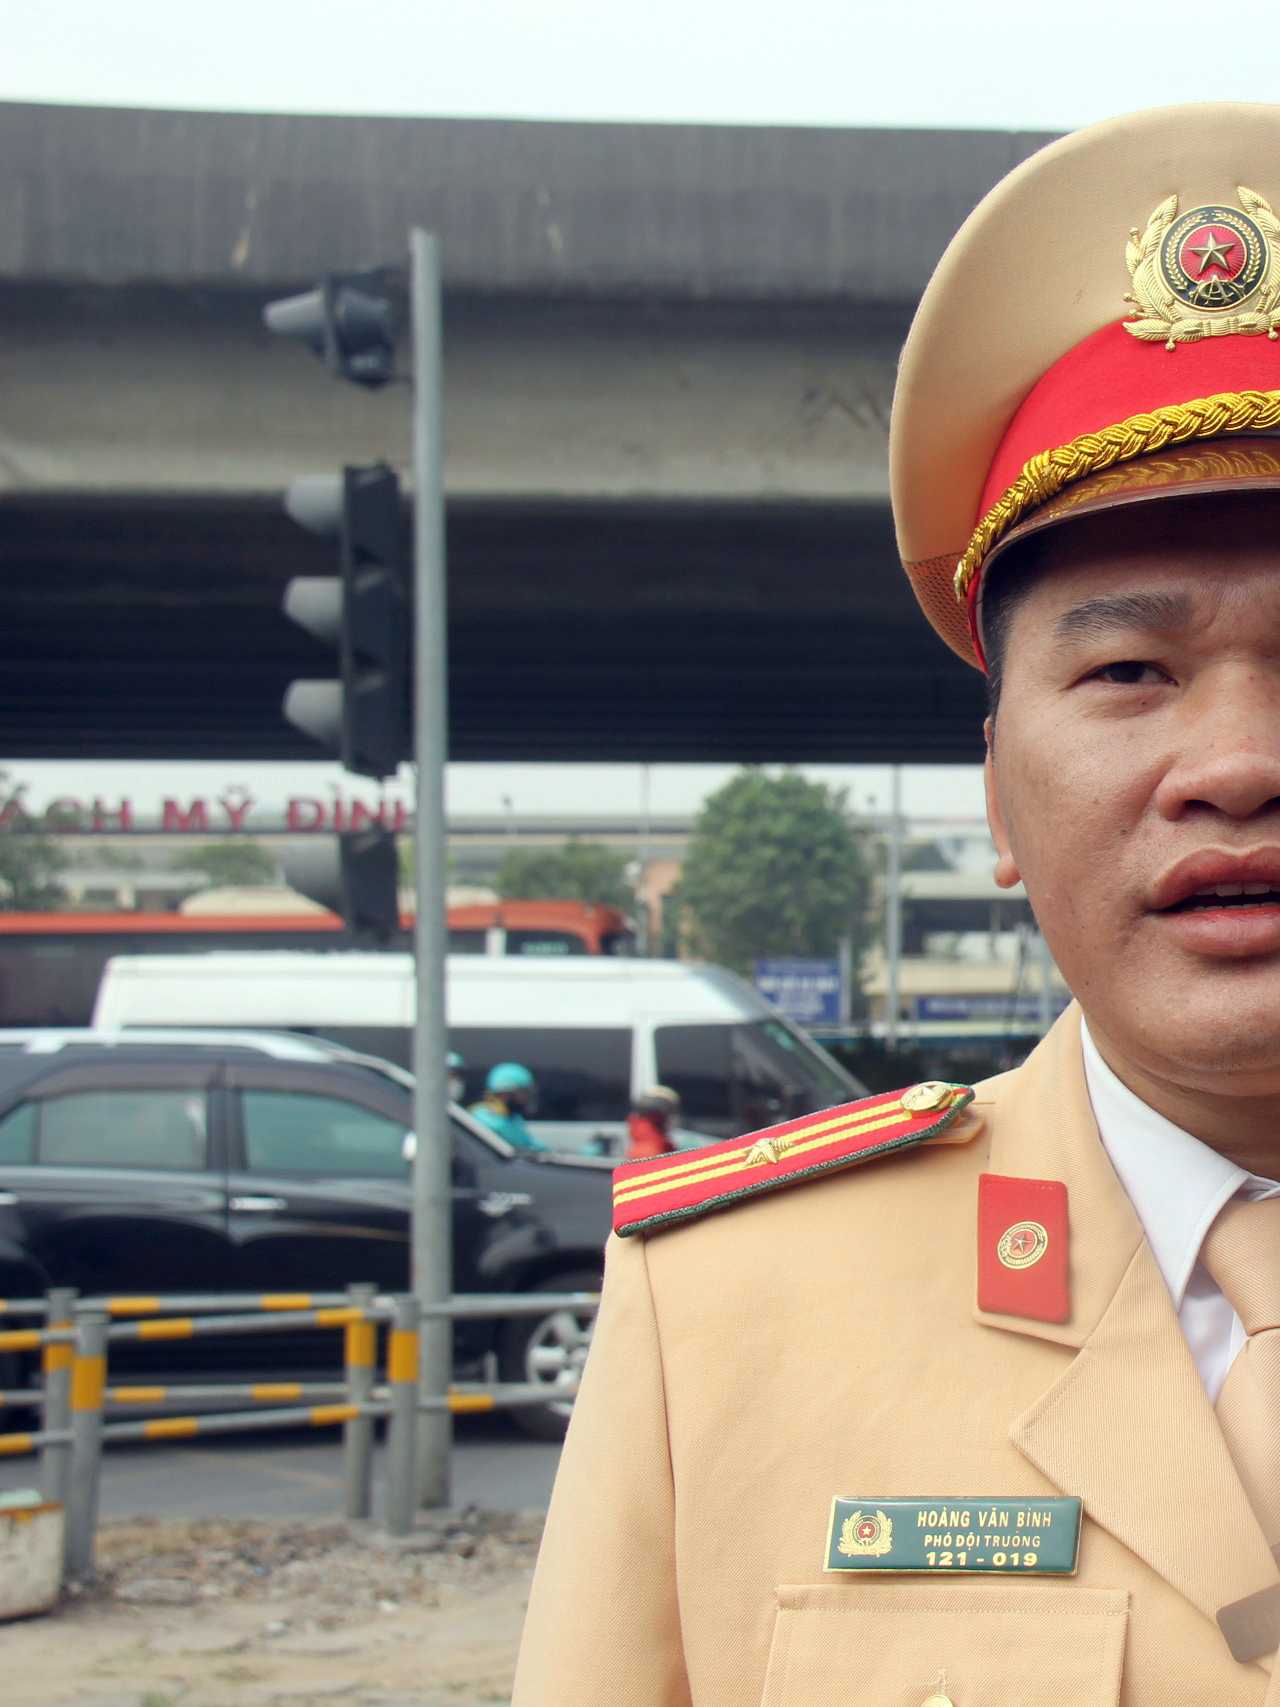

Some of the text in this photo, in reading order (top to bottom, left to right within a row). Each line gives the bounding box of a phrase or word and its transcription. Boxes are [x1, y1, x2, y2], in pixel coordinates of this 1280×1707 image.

[917, 1506, 1052, 1528] HOÀNG VĂN BÌNH
[924, 1532, 952, 1547] PHÓ
[955, 1532, 980, 1551] ĐỘI
[926, 1551, 967, 1566] 121
[992, 1552, 1038, 1566] 019
